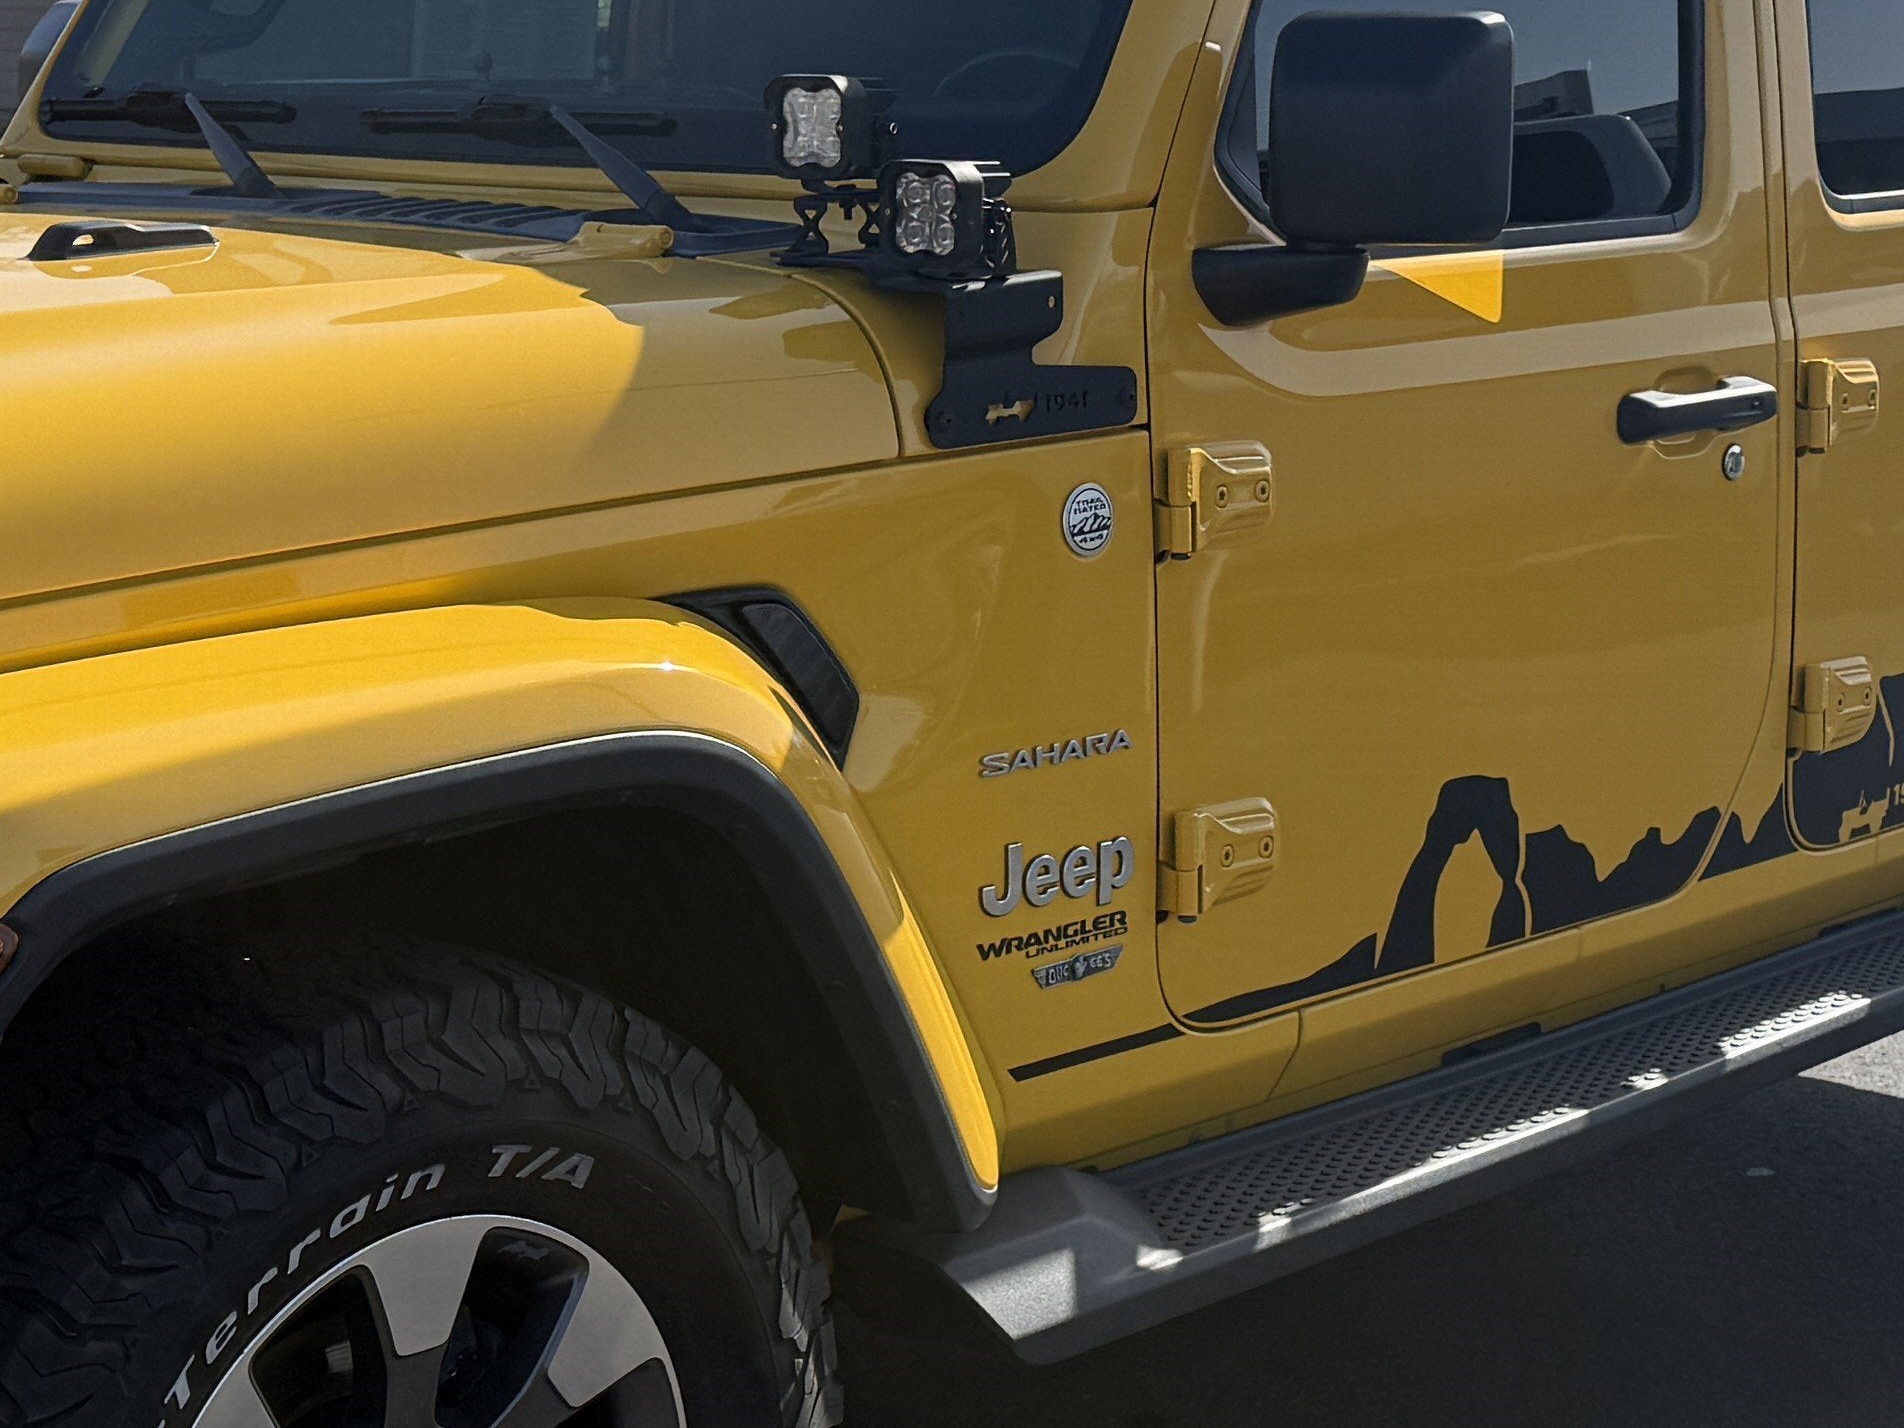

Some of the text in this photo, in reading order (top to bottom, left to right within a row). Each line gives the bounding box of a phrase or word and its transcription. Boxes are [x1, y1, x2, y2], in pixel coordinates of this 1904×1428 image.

[980, 728, 1134, 778] SAHARA
[979, 835, 1135, 918] Jeep
[976, 909, 1128, 962] WRANGLER
[1025, 925, 1128, 959] UNLIMITED
[487, 1143, 595, 1190] T/A
